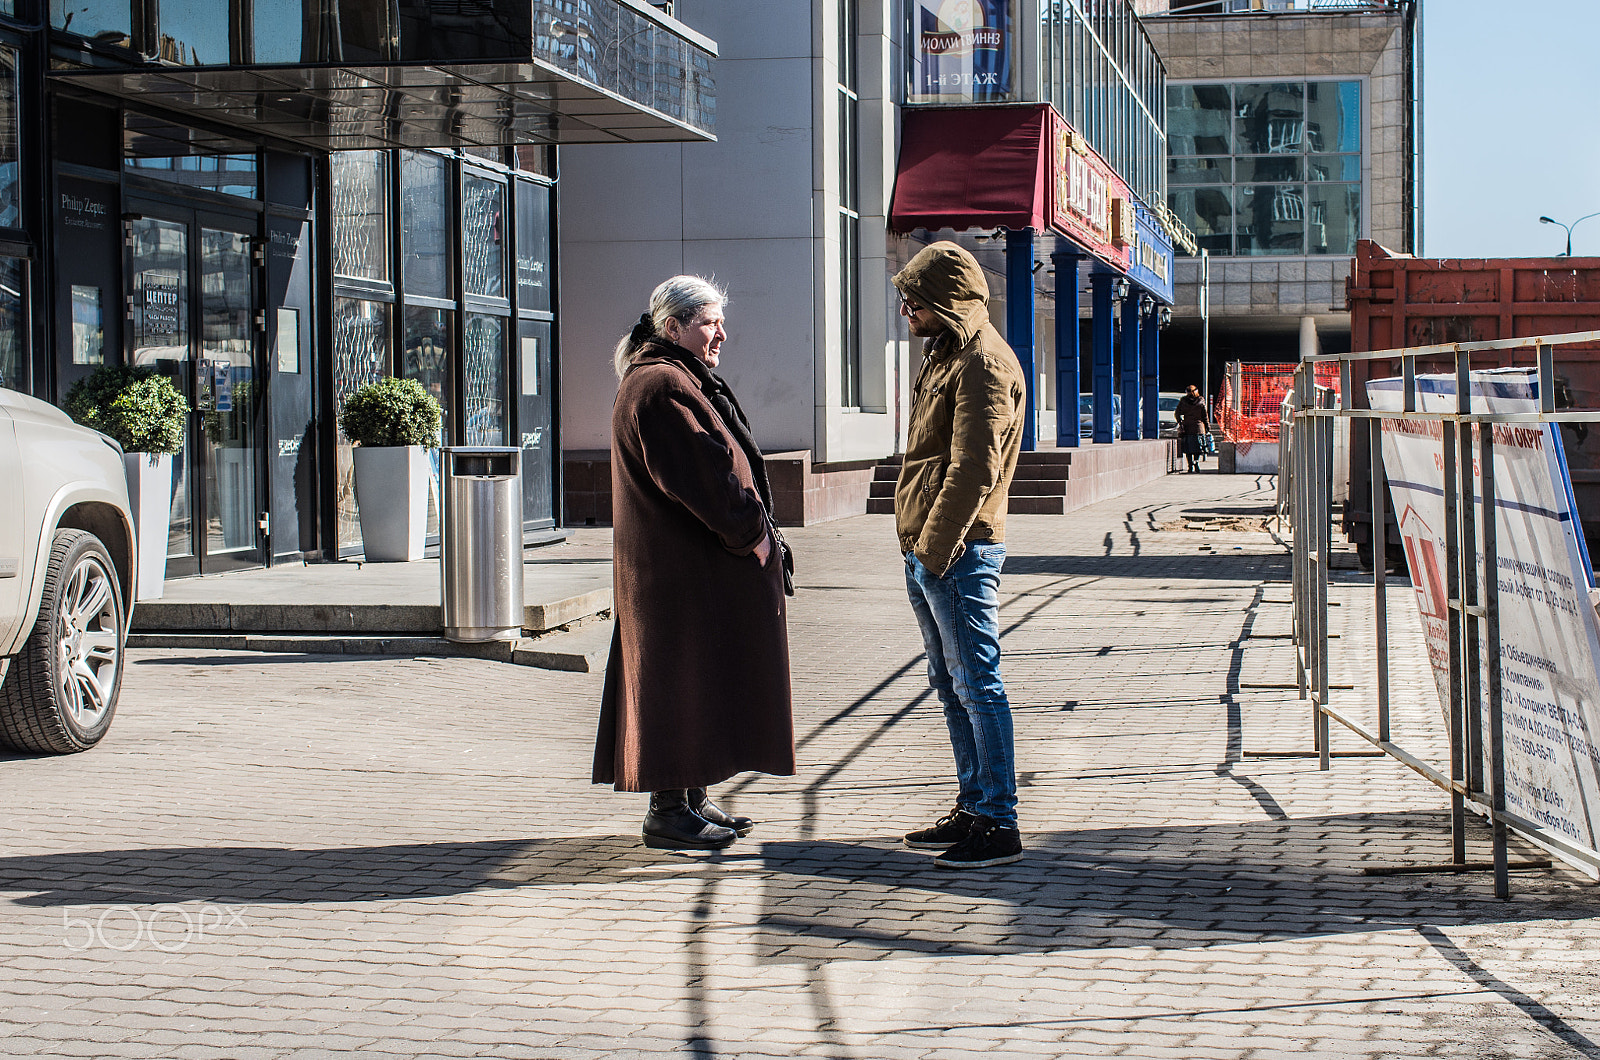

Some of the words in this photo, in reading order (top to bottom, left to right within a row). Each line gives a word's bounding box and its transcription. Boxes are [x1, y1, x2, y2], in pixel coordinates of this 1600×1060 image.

[921, 37, 959, 50] МОЛЛИ
[926, 73, 947, 87] 1-й
[950, 72, 998, 86] ЭТАЖ
[145, 290, 178, 305] ЦЕПТЕР
[1514, 427, 1544, 451] ОКРУГ
